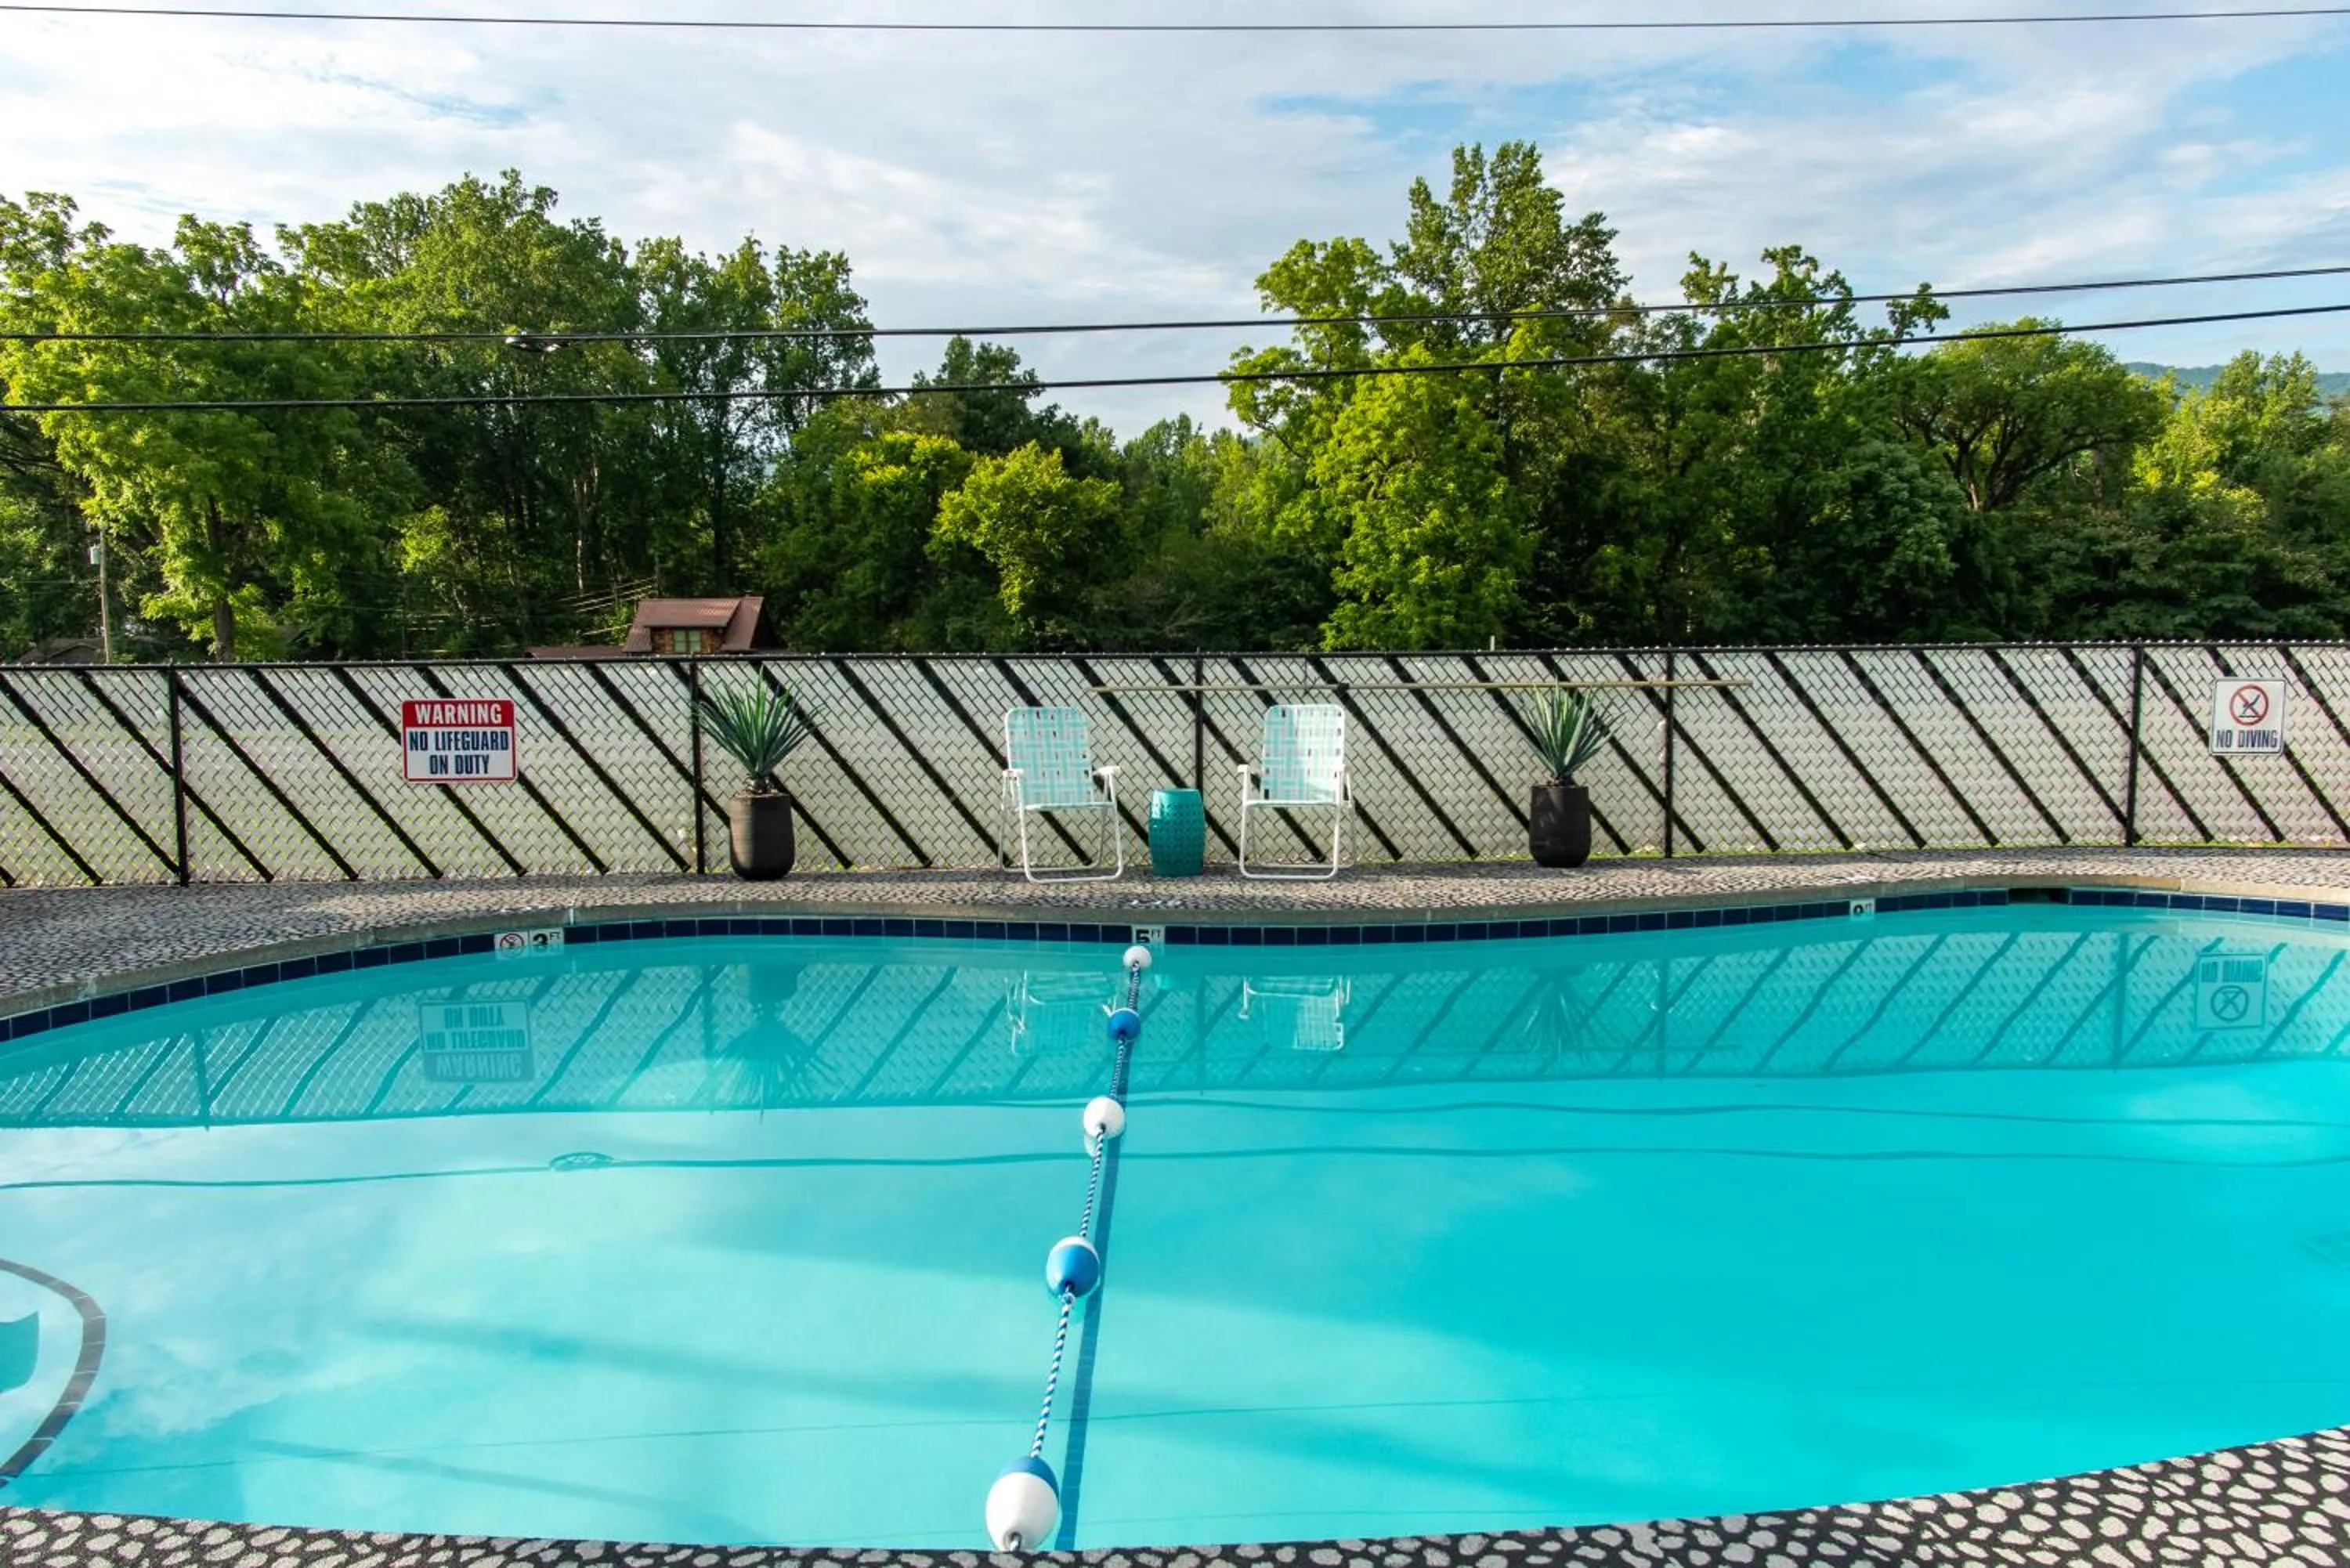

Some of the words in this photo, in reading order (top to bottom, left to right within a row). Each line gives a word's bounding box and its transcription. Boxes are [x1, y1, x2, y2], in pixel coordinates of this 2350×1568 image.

[414, 703, 502, 724] WARNING
[409, 730, 428, 751] NO
[435, 731, 509, 751] LIFEGUARD
[2215, 730, 2232, 748] NO
[2237, 730, 2278, 748] DIVING
[428, 754, 449, 775] ON
[454, 754, 490, 775] DUTY
